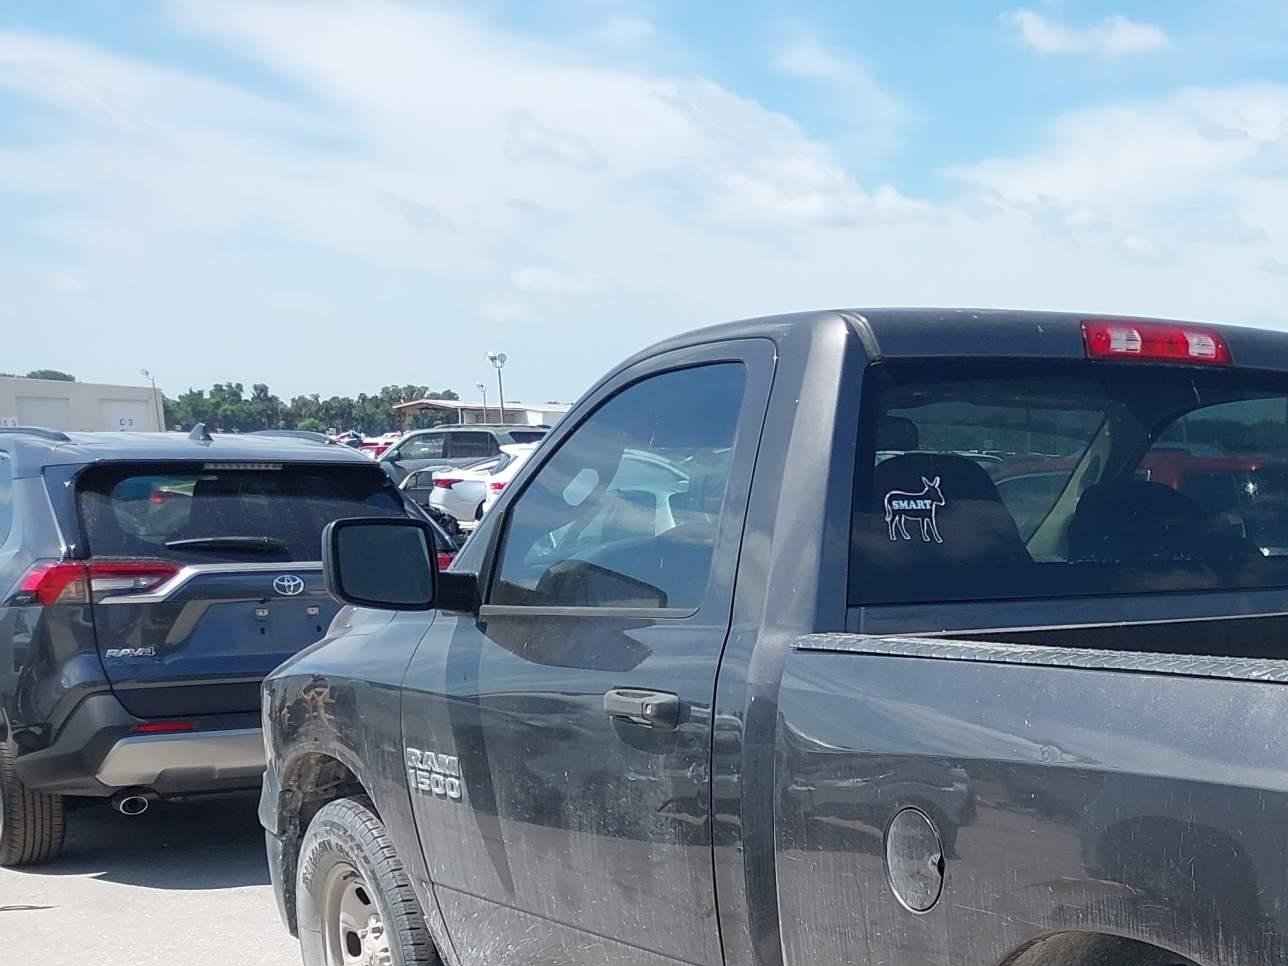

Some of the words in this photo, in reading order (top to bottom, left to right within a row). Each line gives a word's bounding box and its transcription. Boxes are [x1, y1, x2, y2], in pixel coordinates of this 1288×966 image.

[891, 499, 932, 510] SMART
[105, 646, 156, 658] RAV4
[406, 747, 459, 777] RAM
[408, 769, 461, 799] 1500
